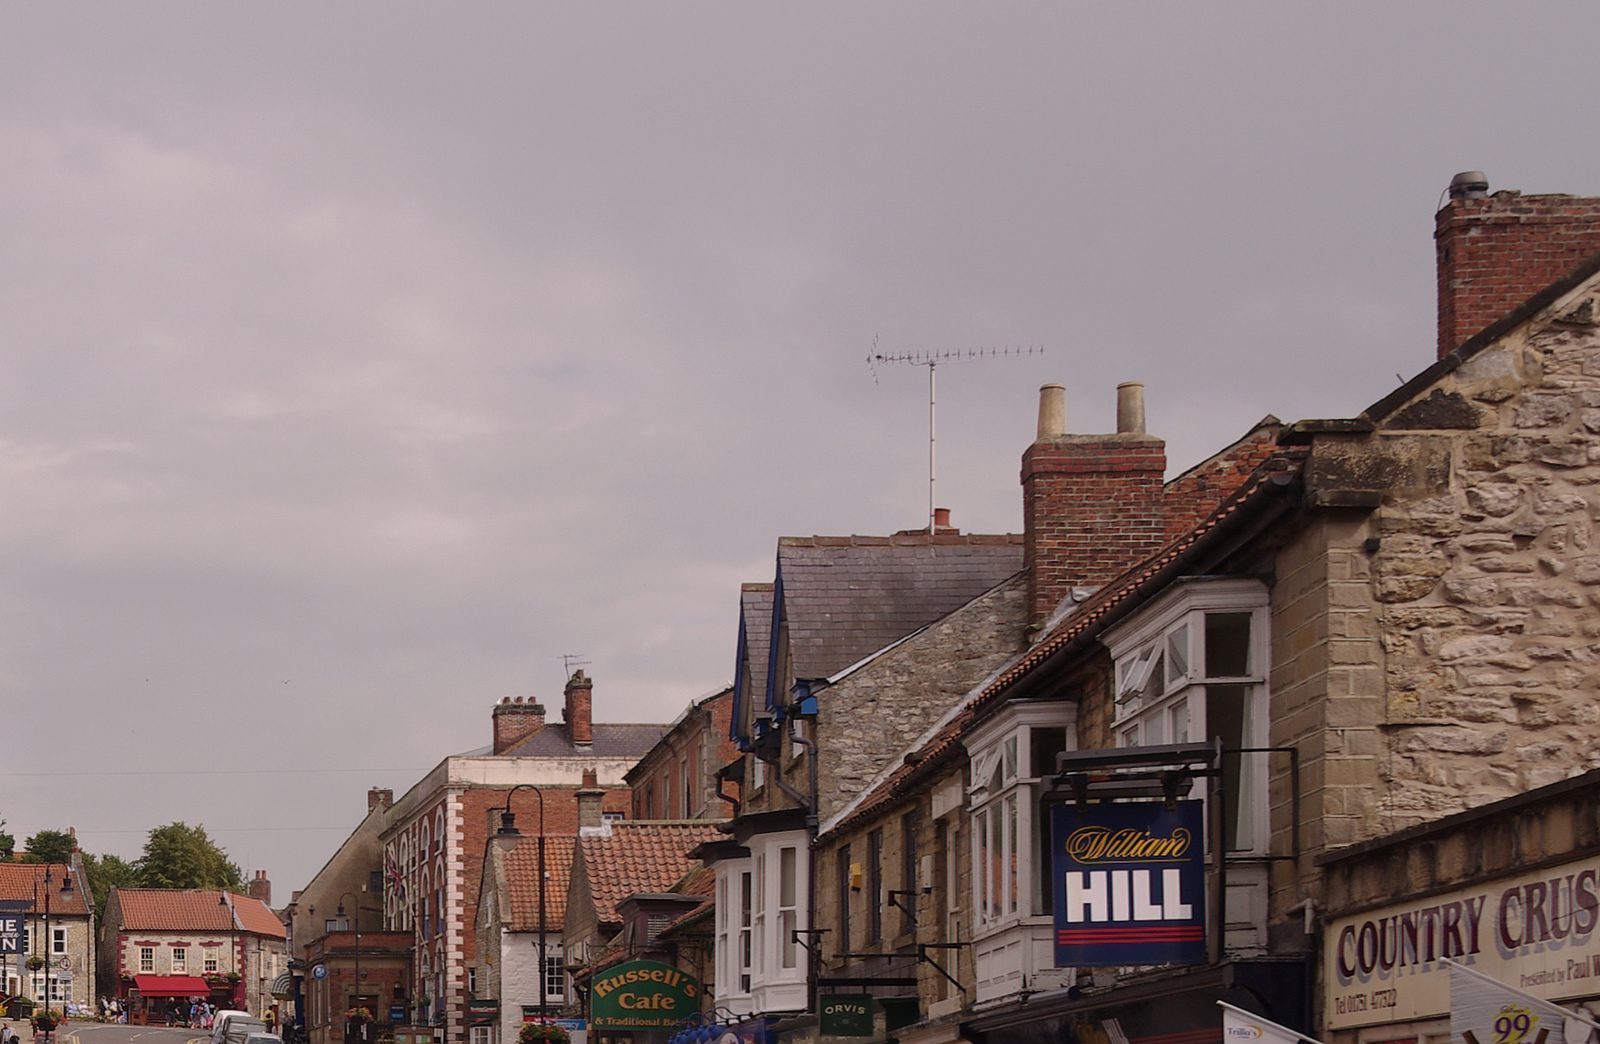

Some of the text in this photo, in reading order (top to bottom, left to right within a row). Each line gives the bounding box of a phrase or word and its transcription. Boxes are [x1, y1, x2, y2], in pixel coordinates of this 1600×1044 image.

[1066, 825, 1192, 864] William
[1065, 868, 1192, 922] HILL
[1337, 869, 1600, 982] COUNTRY CRUS
[1567, 955, 1590, 981] Paul
[594, 969, 697, 998] Russell's
[618, 993, 676, 1010] Cafe
[824, 1004, 866, 1015] ORVIS
[1335, 997, 1346, 1015] Tel
[595, 1017, 603, 1025] &
[606, 1017, 660, 1026] Traditional
[1495, 1014, 1530, 1044] 99
